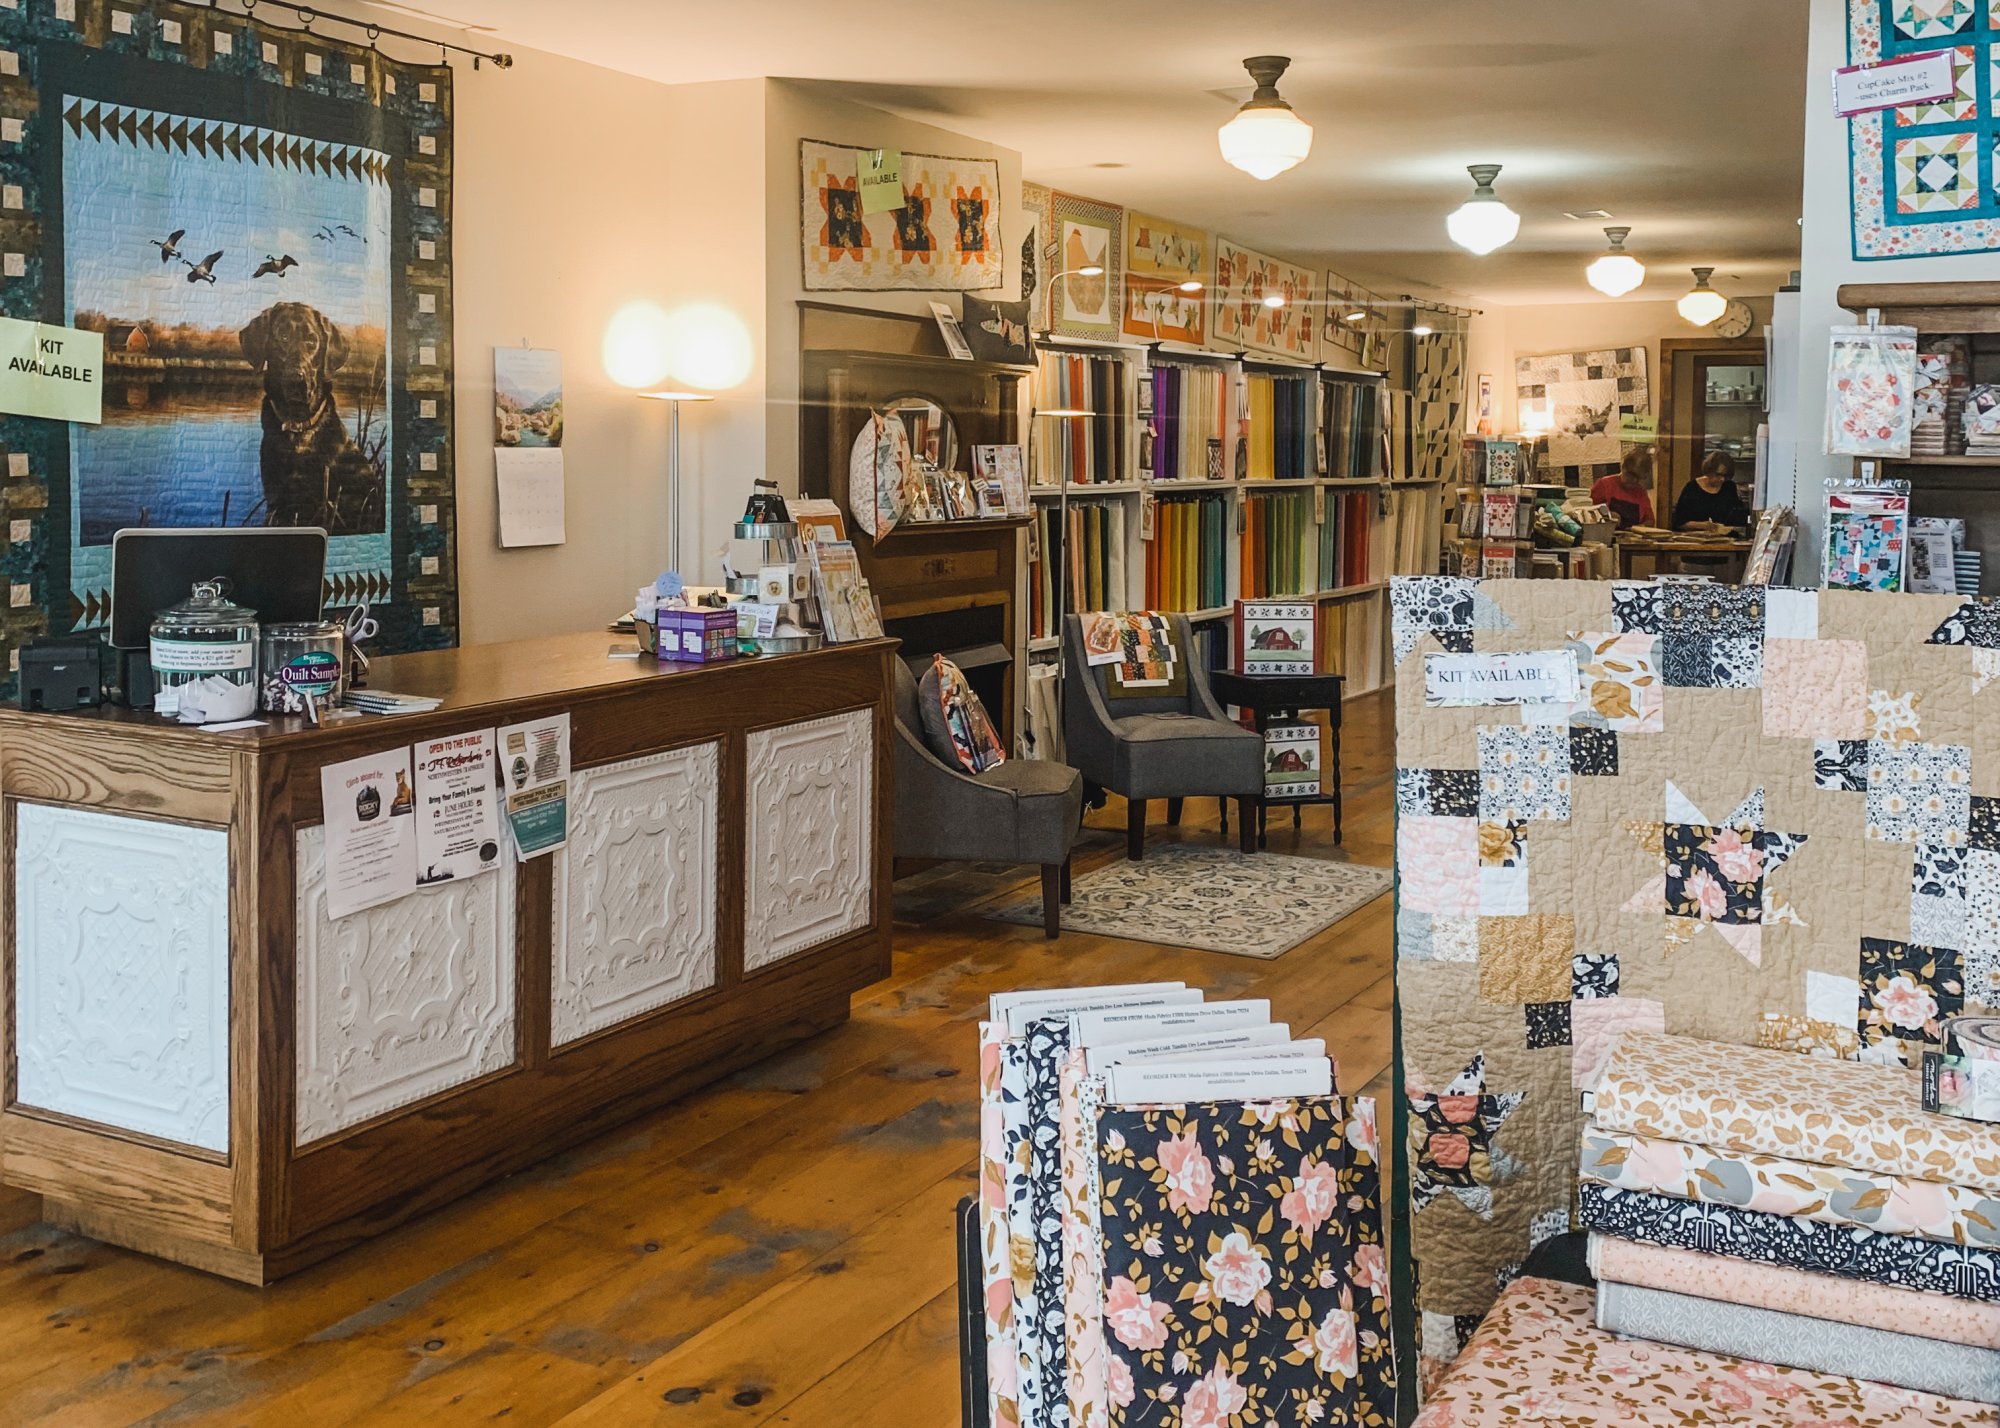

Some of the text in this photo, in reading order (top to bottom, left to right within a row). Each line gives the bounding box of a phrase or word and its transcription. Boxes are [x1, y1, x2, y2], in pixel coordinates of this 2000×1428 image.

[1857, 78, 1896, 91] CupCake
[1898, 73, 1916, 84] Mix
[1879, 86, 1908, 98] Charm
[862, 172, 898, 187] AVAILABLE
[40, 338, 64, 355] KIT
[8, 357, 93, 383] AVAILABLE
[282, 667, 309, 684] Quilt
[1438, 667, 1557, 683] KIT AVAILABLE
[429, 735, 482, 754] OPEN TO THE PUBLIC
[452, 790, 466, 799] Family
[1103, 1015, 1127, 1023] REORDER
